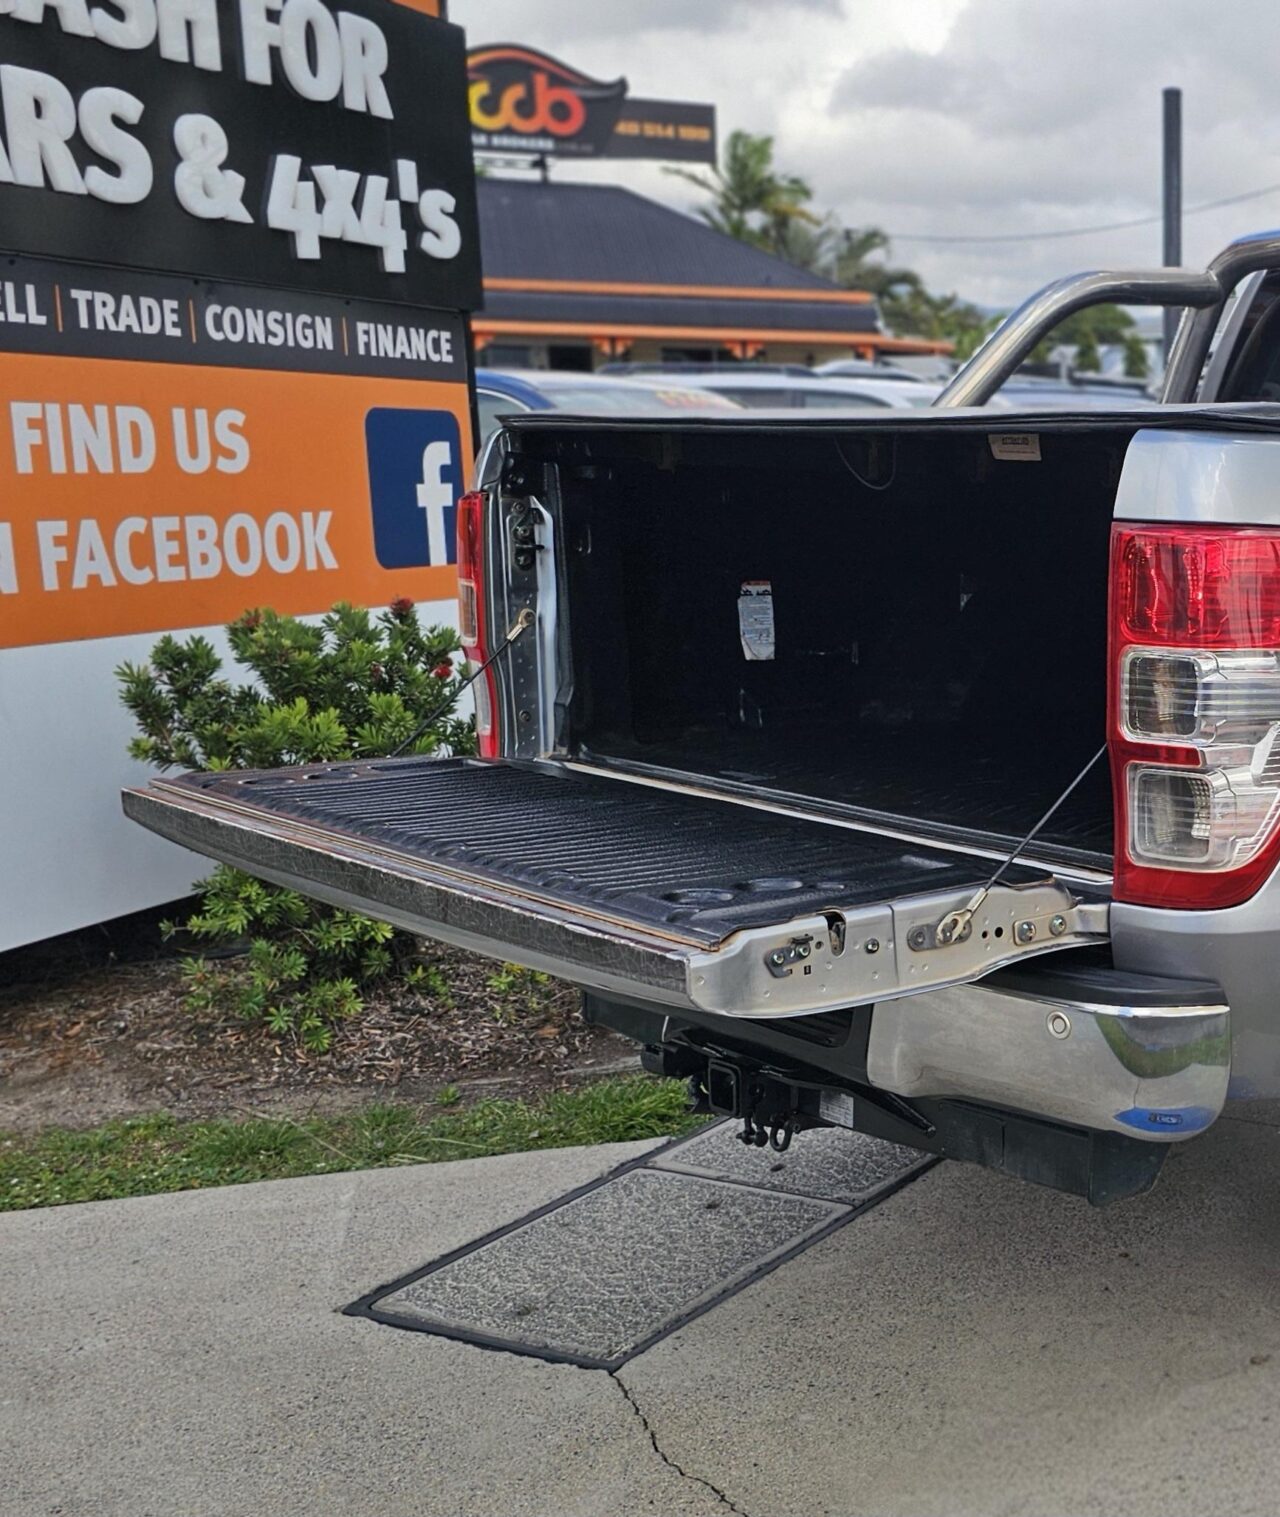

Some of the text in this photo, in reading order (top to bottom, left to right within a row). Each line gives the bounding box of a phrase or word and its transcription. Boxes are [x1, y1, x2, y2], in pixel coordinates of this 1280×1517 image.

[240, 0, 394, 119] FOR
[0, 64, 153, 204] RS
[174, 113, 254, 223] &
[0, 281, 453, 363] LL TRADE CONSIGN FINANCE
[10, 401, 250, 475] FIND US
[37, 511, 338, 592] FACEBOOK
